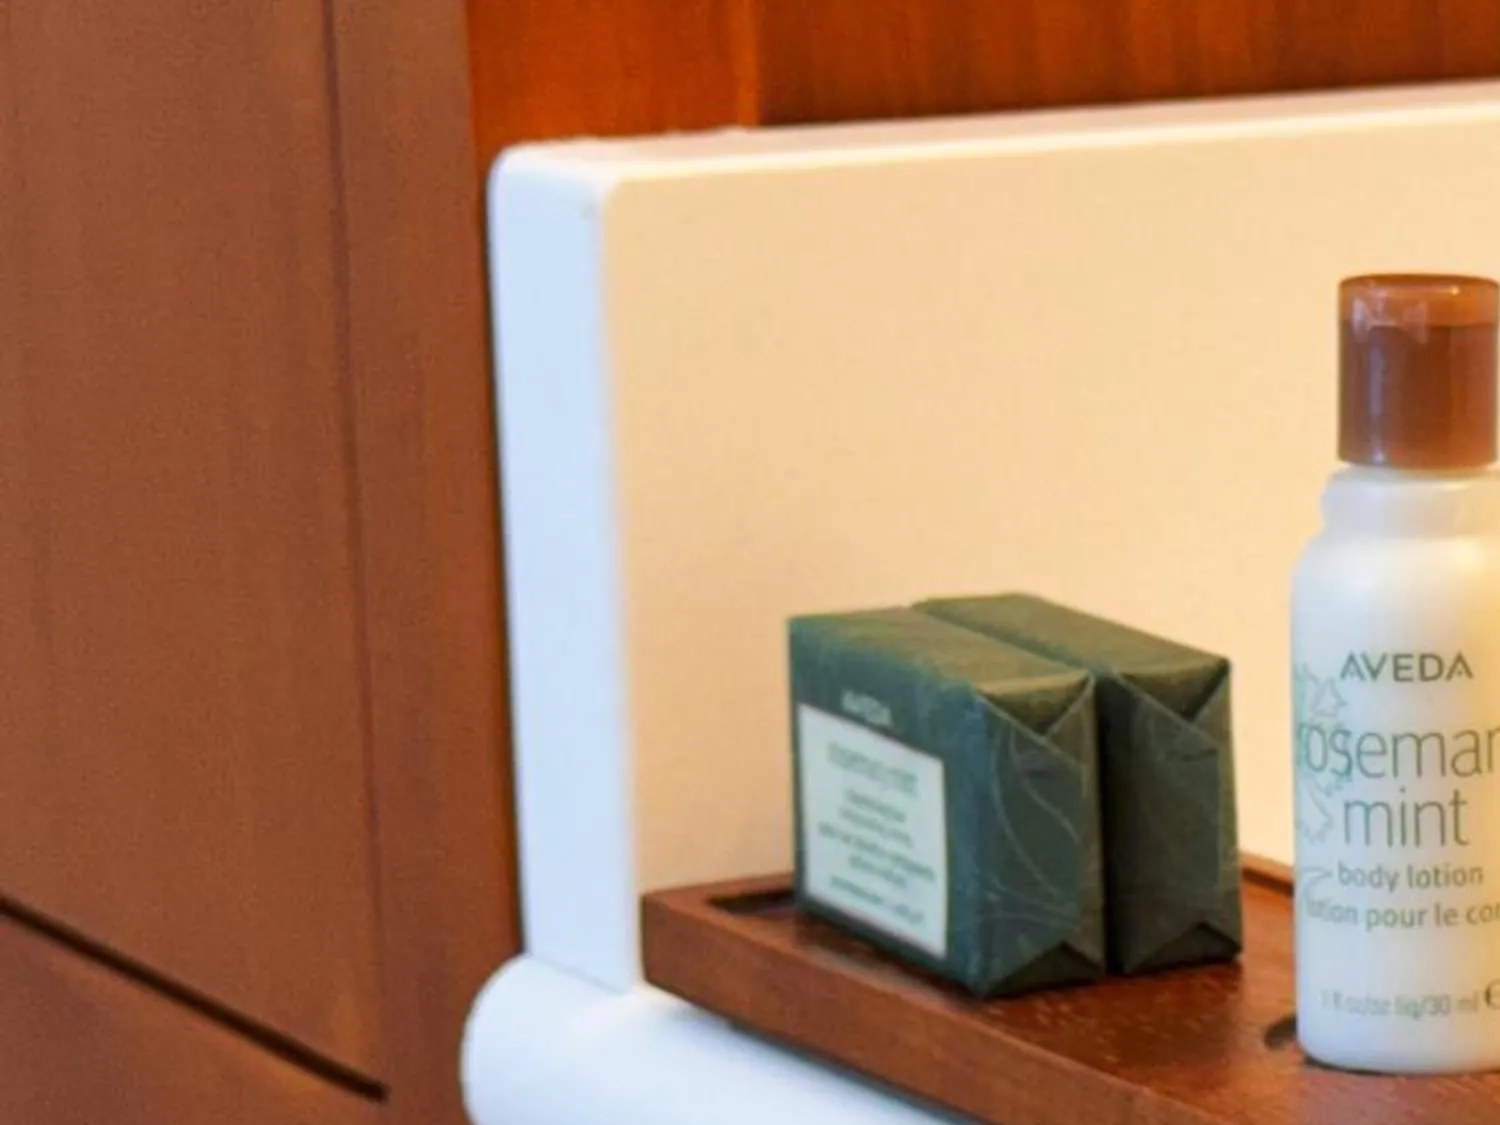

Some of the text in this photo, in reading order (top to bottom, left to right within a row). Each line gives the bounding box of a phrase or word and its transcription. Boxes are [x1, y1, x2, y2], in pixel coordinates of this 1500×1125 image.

[1339, 652, 1474, 682] AVEDA
[1343, 785, 1470, 847] mint
[1338, 860, 1484, 892] body lotion
[1366, 906, 1428, 933] pour
[1434, 903, 1458, 927] le
